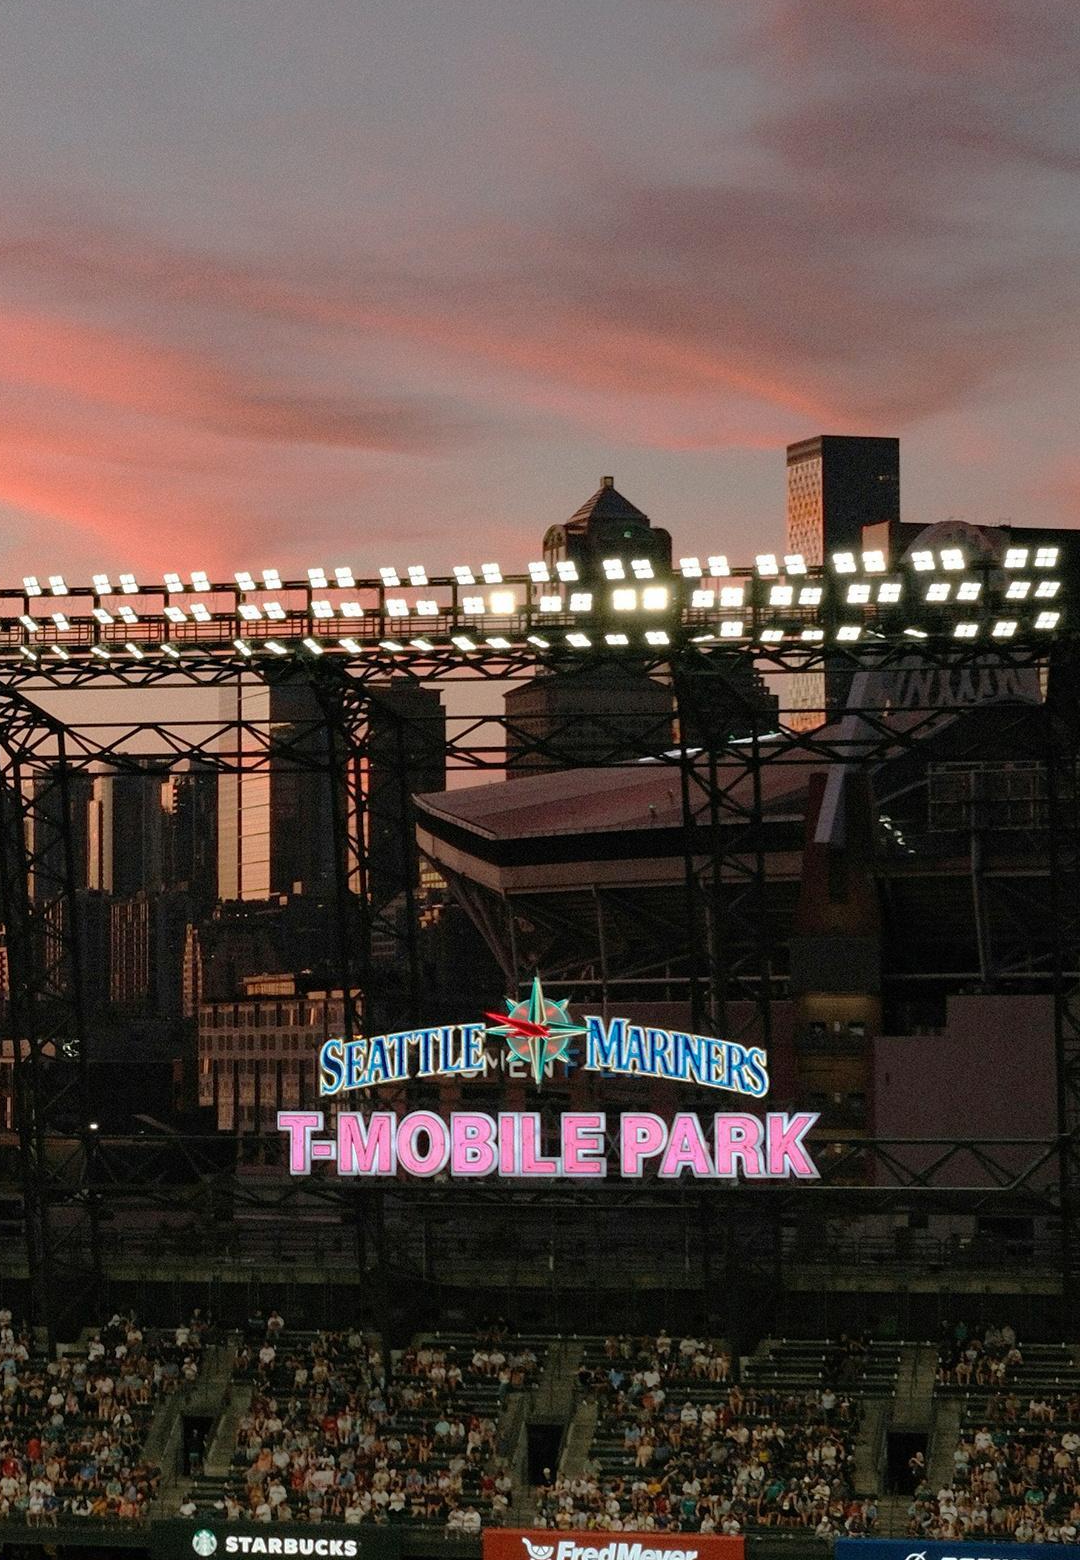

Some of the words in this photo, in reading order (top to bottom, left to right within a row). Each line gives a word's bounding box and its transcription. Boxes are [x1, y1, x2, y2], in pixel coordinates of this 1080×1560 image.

[320, 1023, 488, 1096] SEATTLE
[584, 1015, 769, 1098] MARINERS
[277, 1111, 607, 1177] T-MOBILE
[620, 1111, 821, 1178] PARK
[226, 1536, 357, 1556] STARBUCKS
